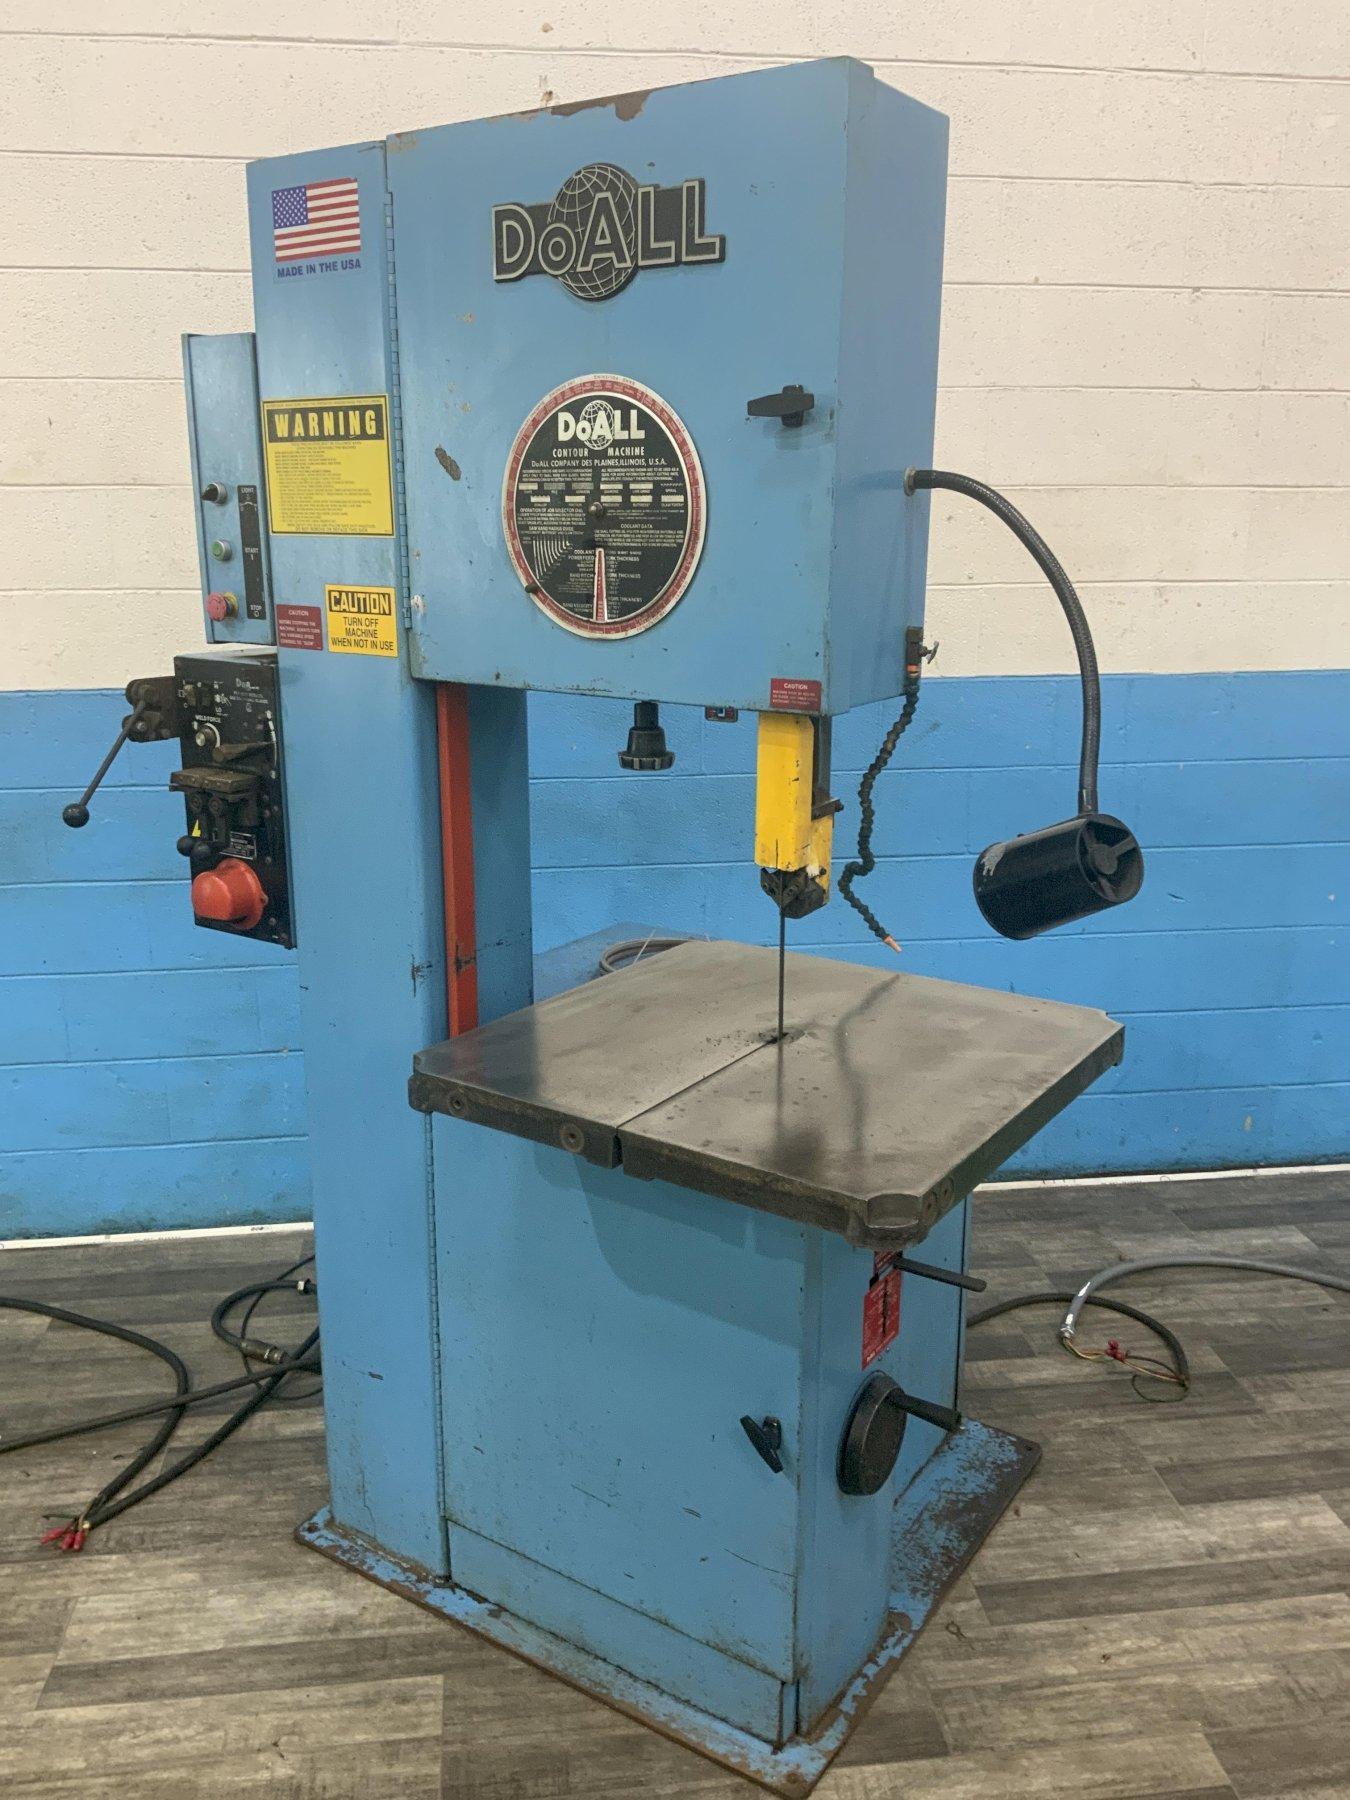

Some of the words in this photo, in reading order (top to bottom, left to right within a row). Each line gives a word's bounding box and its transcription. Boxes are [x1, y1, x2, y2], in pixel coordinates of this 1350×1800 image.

[493, 179, 724, 283] DoALL
[277, 266, 303, 278] MADE
[305, 264, 316, 276] IN
[319, 262, 338, 274] THE
[341, 260, 362, 272] USA
[274, 410, 377, 438] WARNING
[557, 410, 646, 441] DoALL
[552, 448, 589, 458] CONTOUR
[607, 446, 645, 457] MACHINE
[531, 460, 549, 468] DoALL
[550, 459, 580, 468] COMPANY
[581, 459, 593, 467] DES
[649, 458, 668, 467] U.S.A.
[330, 591, 390, 614] CAUTION
[288, 609, 309, 617] CAUTION
[343, 616, 363, 626] TURN
[365, 618, 379, 628] OFF
[345, 628, 378, 639] MACHINE
[331, 638, 352, 647] WHEN
[353, 639, 368, 649] NOT
[371, 640, 378, 649] IN
[380, 641, 394, 651] USE
